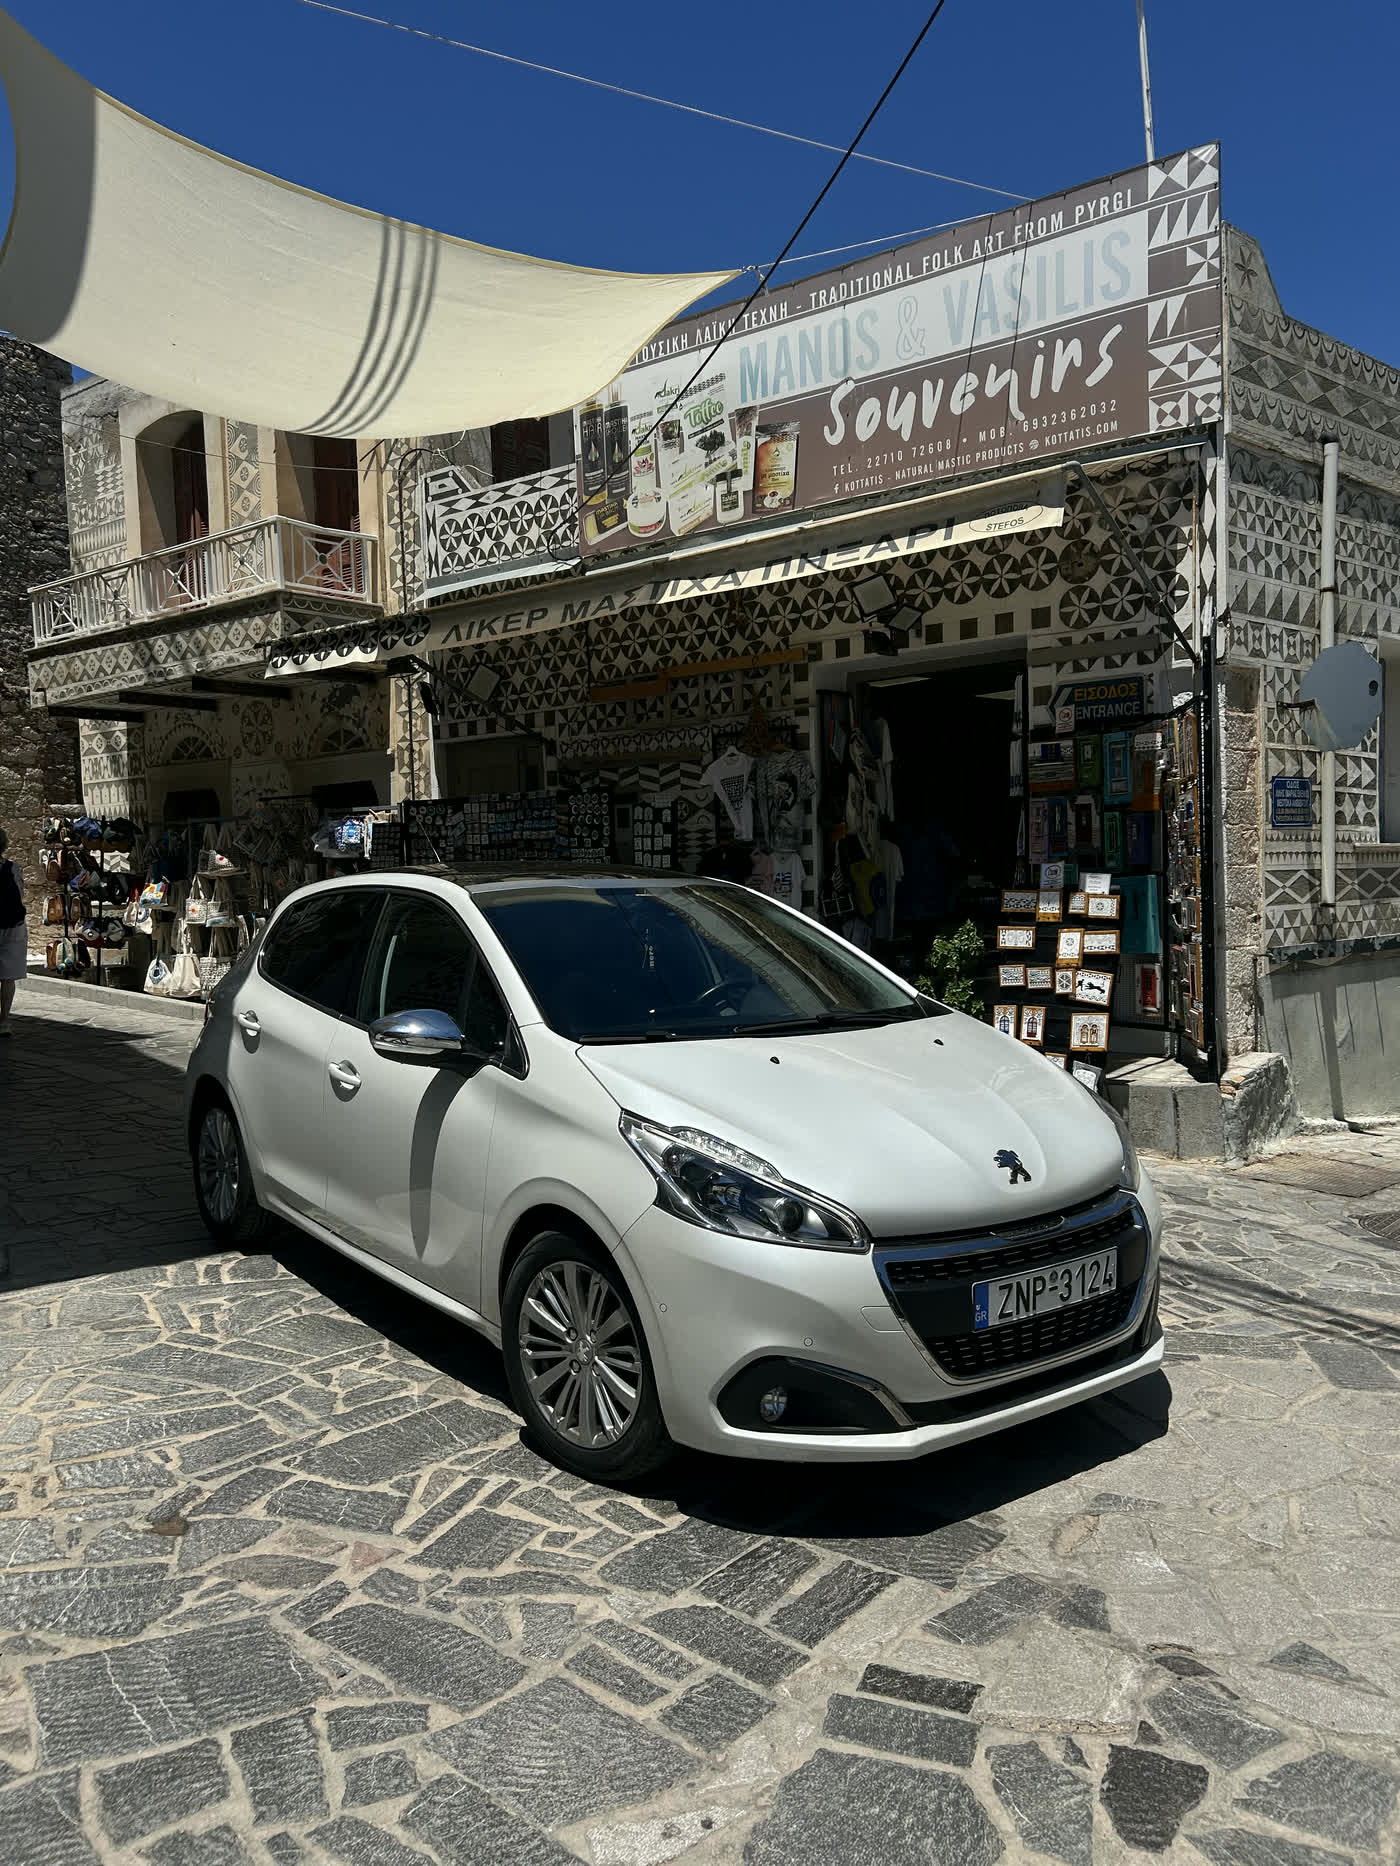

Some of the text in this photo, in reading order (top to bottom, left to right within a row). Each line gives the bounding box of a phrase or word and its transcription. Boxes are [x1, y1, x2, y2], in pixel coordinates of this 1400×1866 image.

[743, 301, 788, 330] ΤΕΧΝΗ
[809, 261, 914, 310] TRADITIONAL
[922, 245, 964, 274] FOLK
[972, 231, 1005, 256] ART
[1014, 211, 1064, 245] FROM
[1074, 188, 1133, 225] PYRGI
[740, 230, 1133, 405] MANOS & VASILIS
[823, 323, 1124, 446] Souvenirs
[832, 400, 1117, 476] TEL. 22710 72608 MOB. 6932362032
[844, 475, 883, 493] KOTTATIS
[895, 463, 934, 481] NATURAL
[937, 454, 971, 471] MASTIC
[975, 442, 1024, 463] PRODUCTS
[1045, 420, 1118, 447] KOTTATIS.COM
[985, 516, 1025, 531] STEFOS
[440, 607, 549, 645] ΛΙΚΕΡ
[560, 568, 742, 623] ΜΑΣΤΙΧΑ
[1073, 681, 1137, 703] ΕΙΣΟΔΟΣ
[1075, 701, 1141, 721] ENTRANCE
[974, 1309, 987, 1322] GR
[997, 1254, 1114, 1320] ZNP-3124
